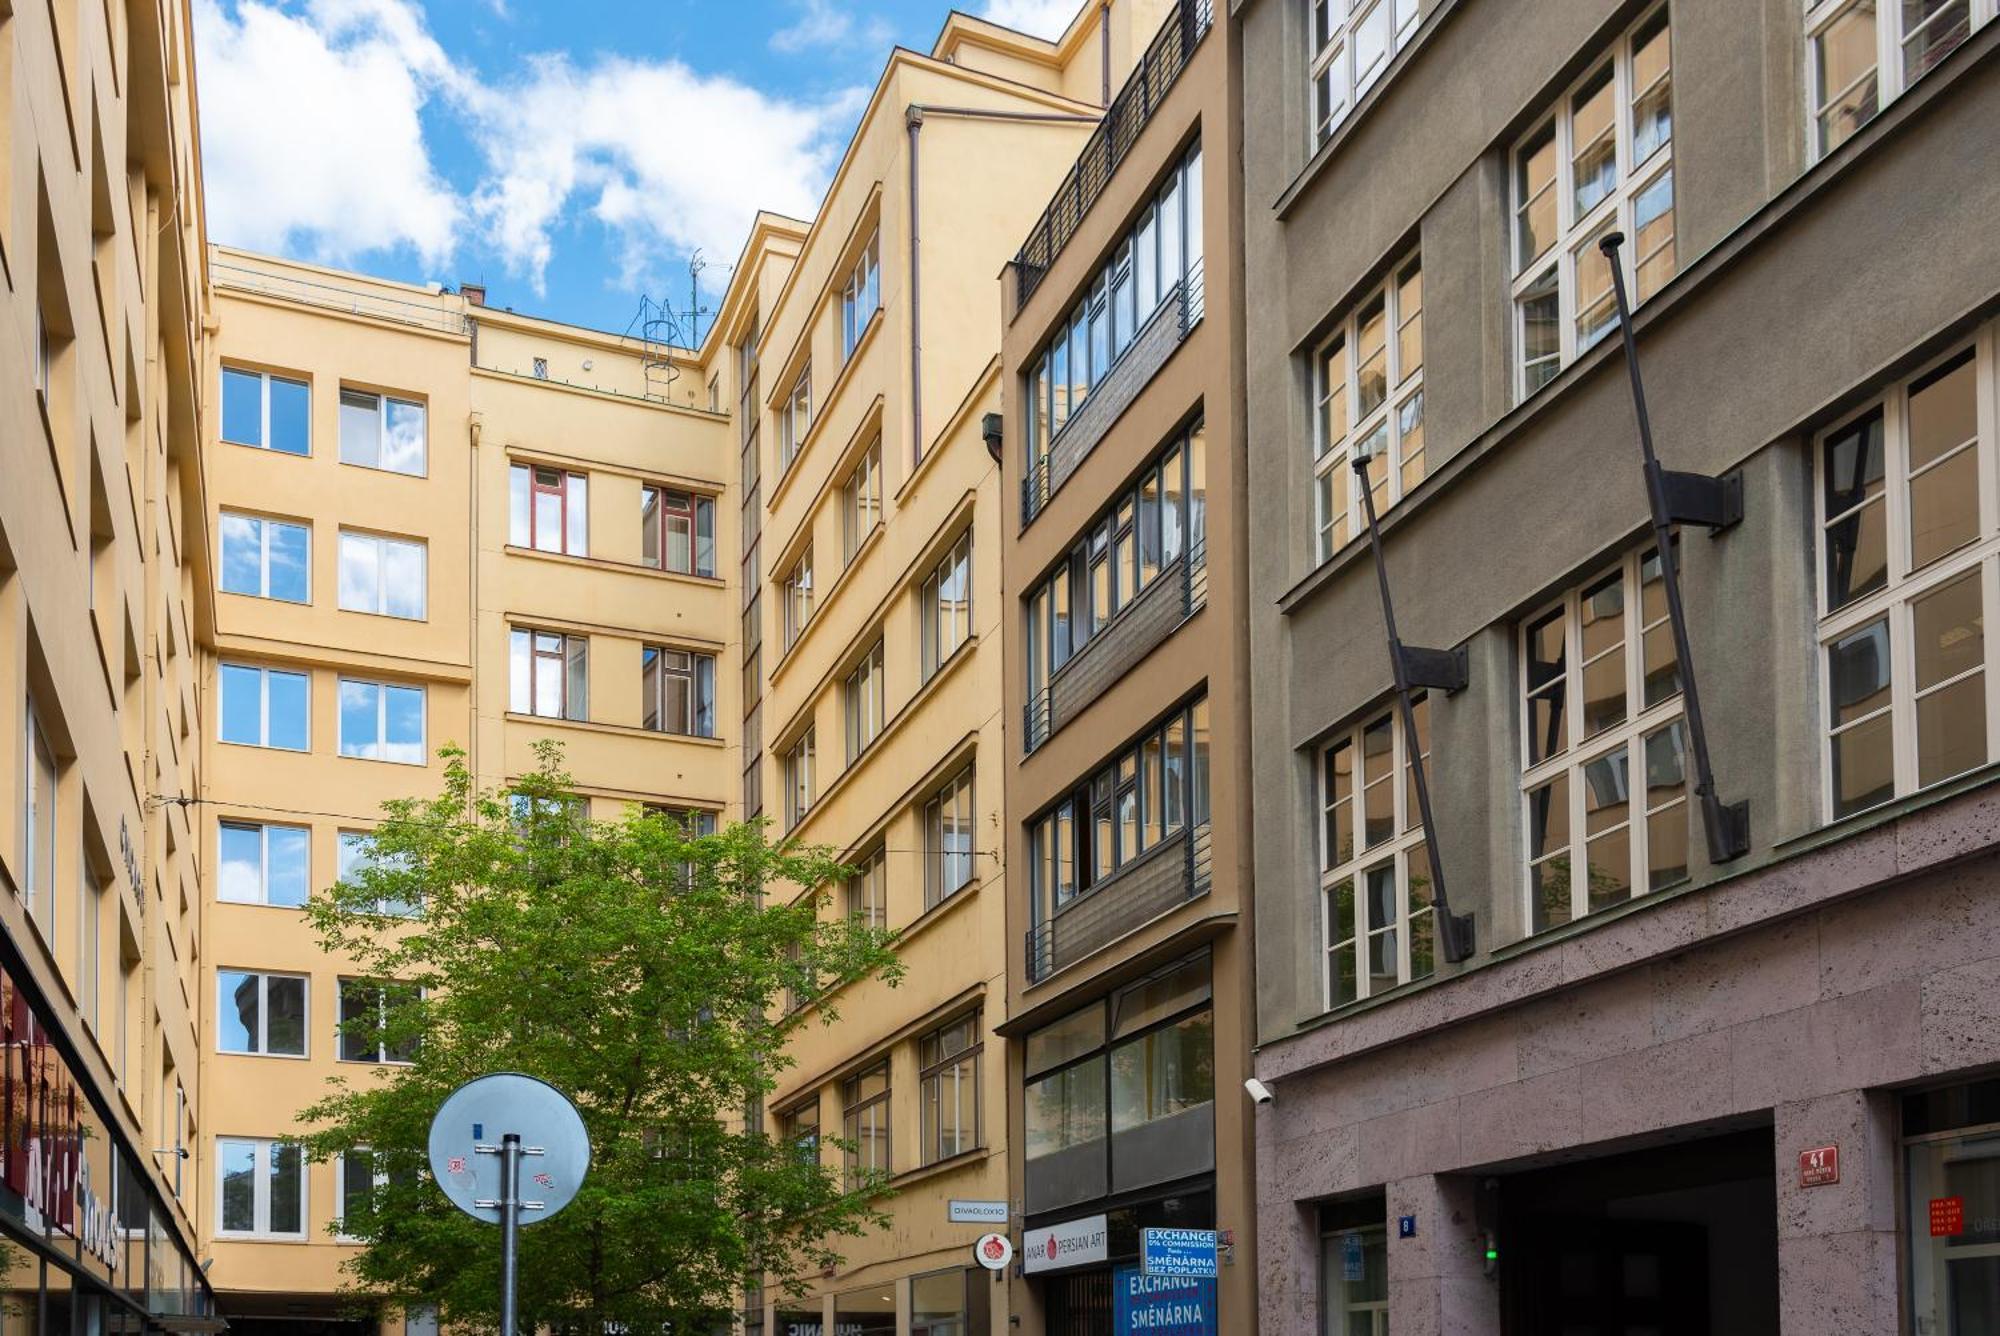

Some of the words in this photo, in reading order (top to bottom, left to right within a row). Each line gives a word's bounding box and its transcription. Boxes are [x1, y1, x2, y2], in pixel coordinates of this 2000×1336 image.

[1811, 1152, 1824, 1168] 41
[1403, 1220, 1409, 1232] 8
[1148, 1230, 1214, 1242] EXCHANGE
[1027, 1244, 1046, 1261] ANAR
[1058, 1234, 1089, 1254] PERSIAN
[1090, 1231, 1105, 1249] ART
[1162, 1241, 1214, 1249] COMMISSION
[1147, 1255, 1215, 1267] SMĚNÁRNA
[1168, 1267, 1216, 1275] POPLATKU
[1131, 1302, 1202, 1329] SMĚNÁRNA
